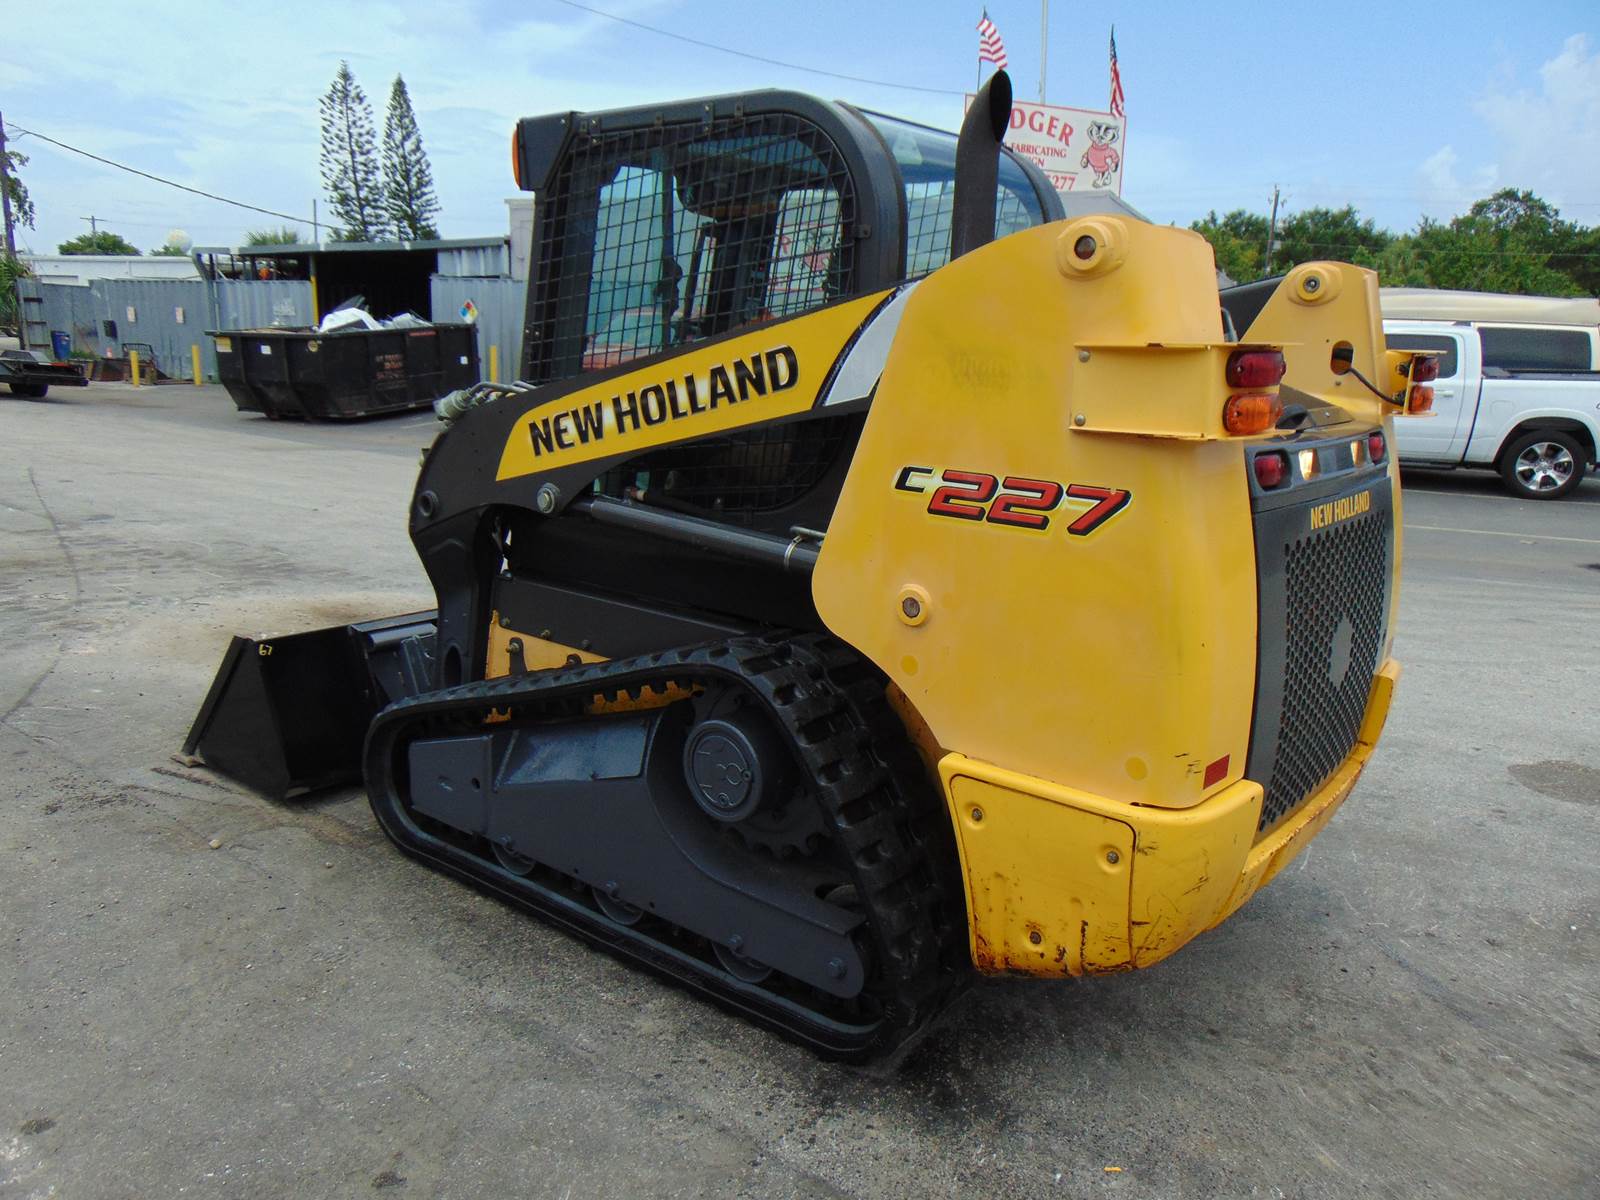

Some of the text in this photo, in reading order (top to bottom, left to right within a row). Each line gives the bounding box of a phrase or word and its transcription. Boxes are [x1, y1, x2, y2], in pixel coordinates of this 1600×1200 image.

[1010, 109, 1073, 146] DGER
[1011, 143, 1067, 157] FABRICATING
[528, 344, 799, 457] NEW HOLLAND
[894, 466, 1132, 536] C227
[1311, 491, 1368, 529] NEW HOLLAND
